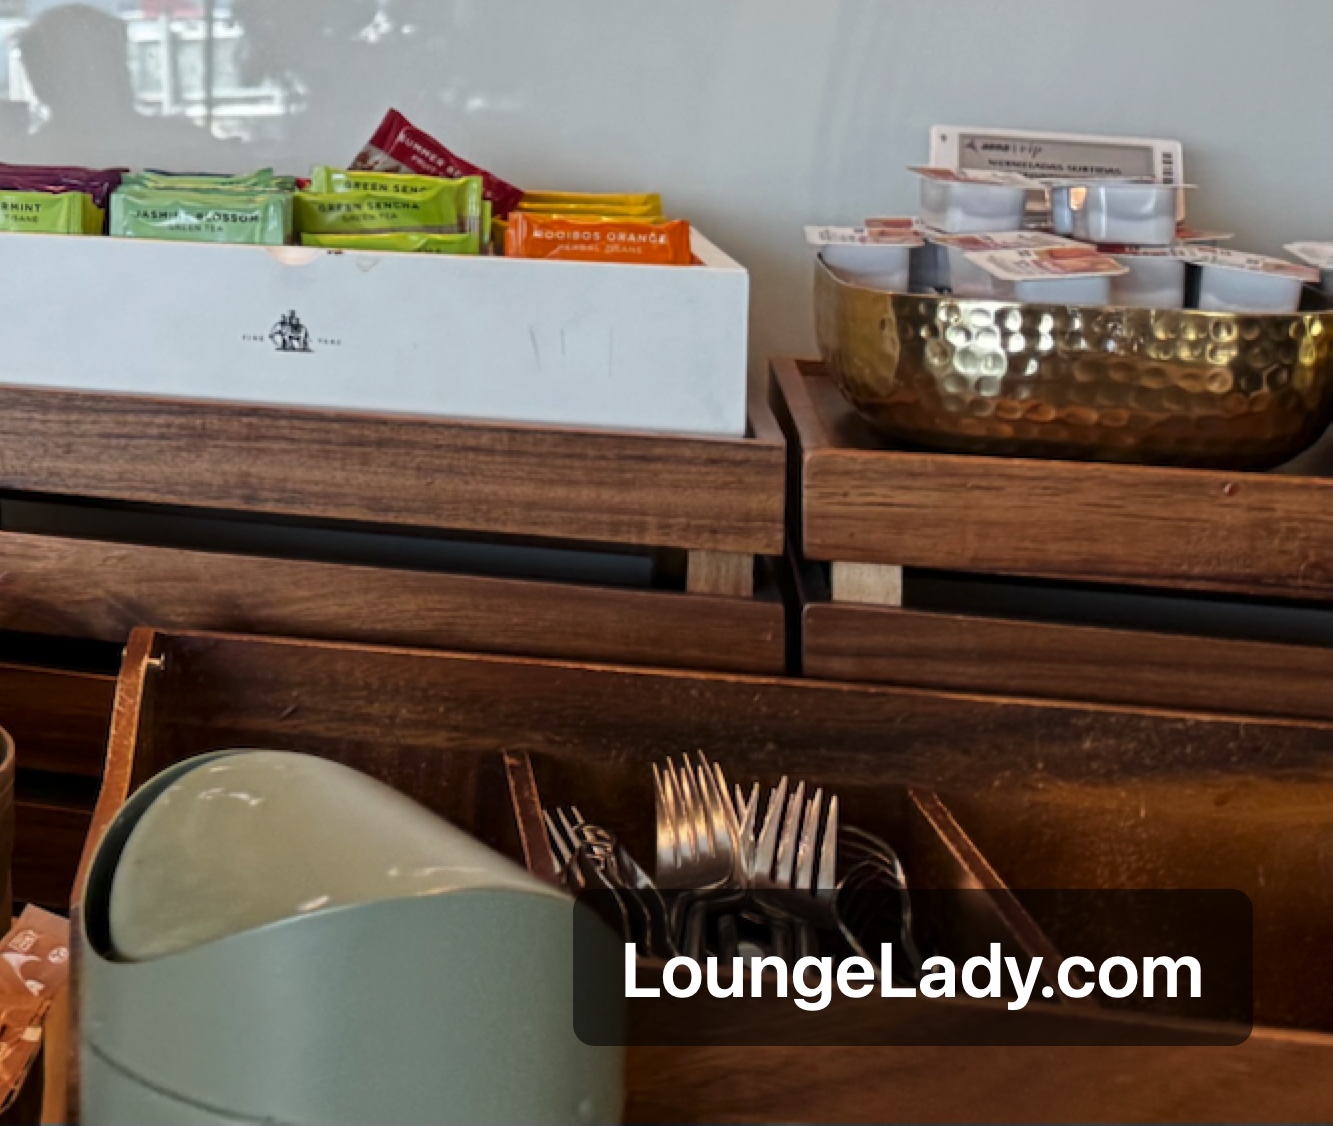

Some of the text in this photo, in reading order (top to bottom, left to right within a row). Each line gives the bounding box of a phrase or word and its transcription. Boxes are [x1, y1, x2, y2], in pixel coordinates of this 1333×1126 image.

[344, 180, 388, 192] GREEN
[367, 201, 420, 211] SENCHA
[606, 231, 667, 245] ORANGE
